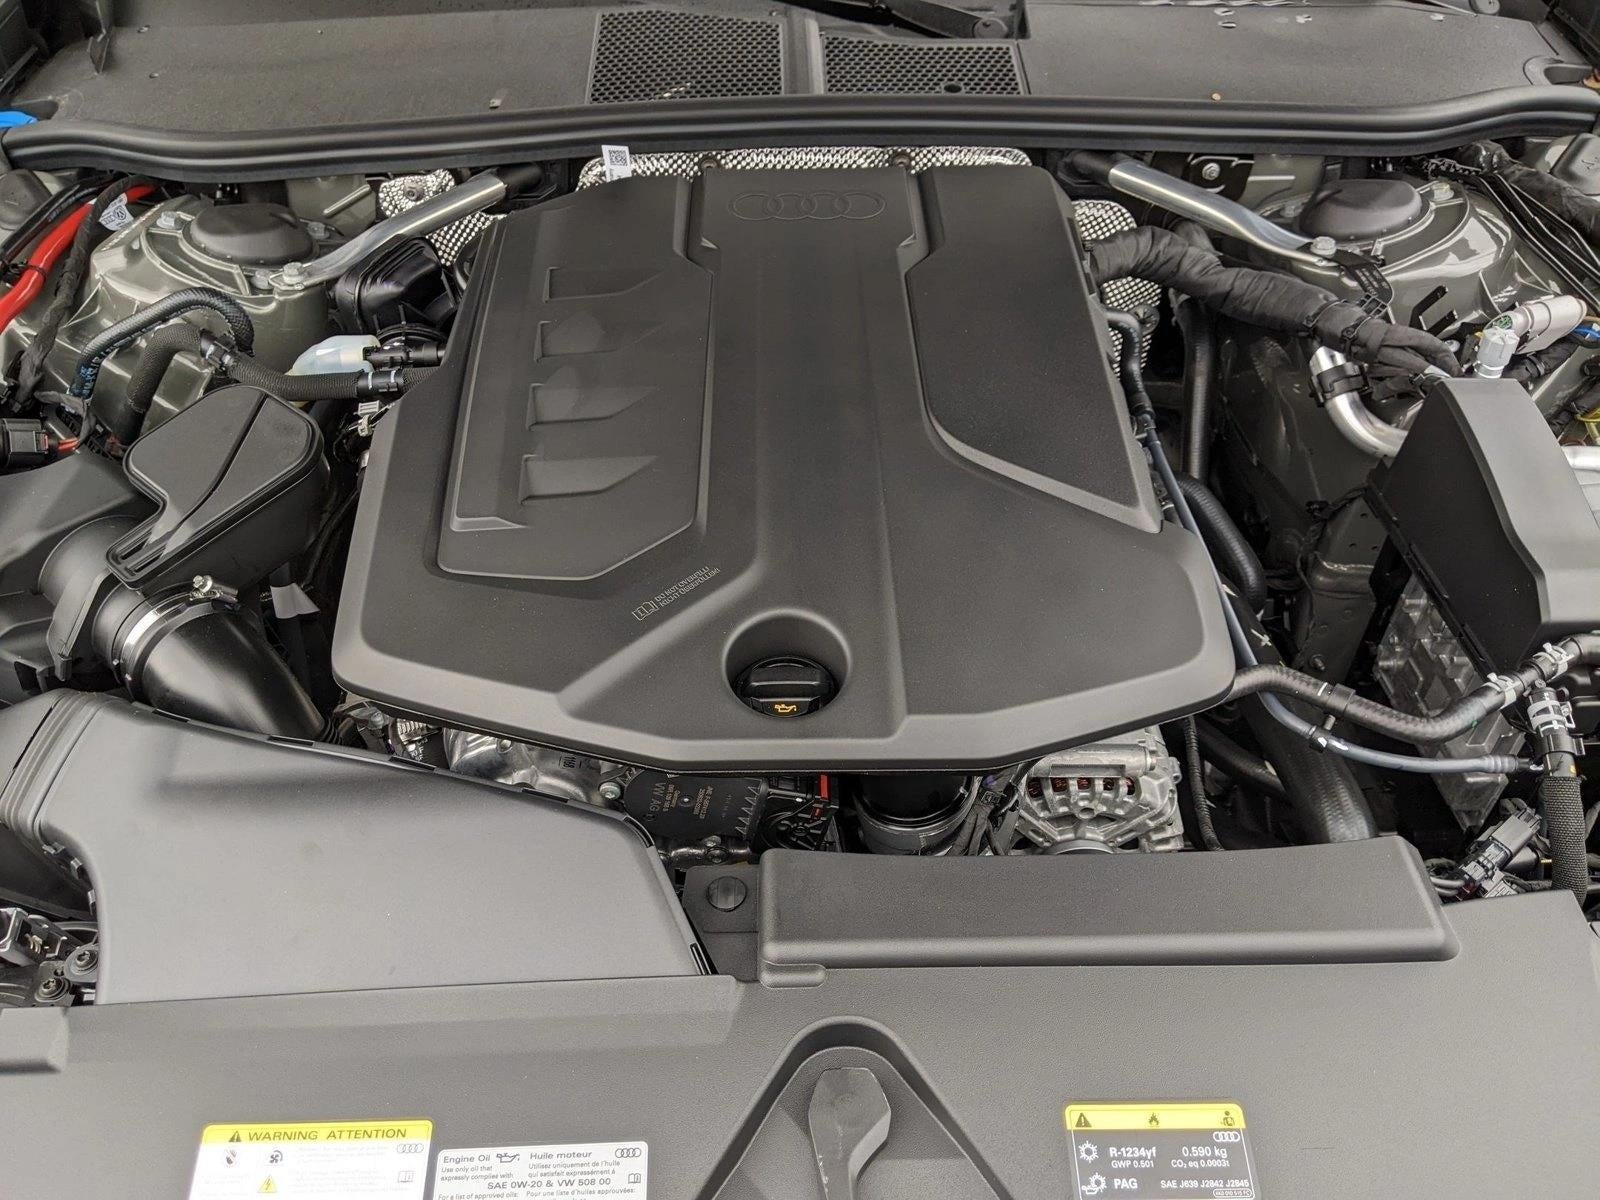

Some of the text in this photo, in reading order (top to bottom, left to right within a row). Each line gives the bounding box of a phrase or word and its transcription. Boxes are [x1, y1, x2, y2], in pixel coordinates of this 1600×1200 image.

[248, 1128, 407, 1142] WARNING ATTENTION
[530, 1151, 592, 1160] Huile moteur
[1109, 1147, 1156, 1159] R-1234yf
[1182, 1146, 1228, 1158] 0.590 kg
[443, 1154, 491, 1164] Engine Oil
[1111, 1160, 1131, 1168] GWP
[487, 1177, 611, 1190] SAE 0W-20 & VW 508 00
[1113, 1178, 1138, 1189] PAG
[1160, 1180, 1178, 1188] SAE
[1201, 1179, 1224, 1187] J2842
[475, 1191, 505, 1199] approved
